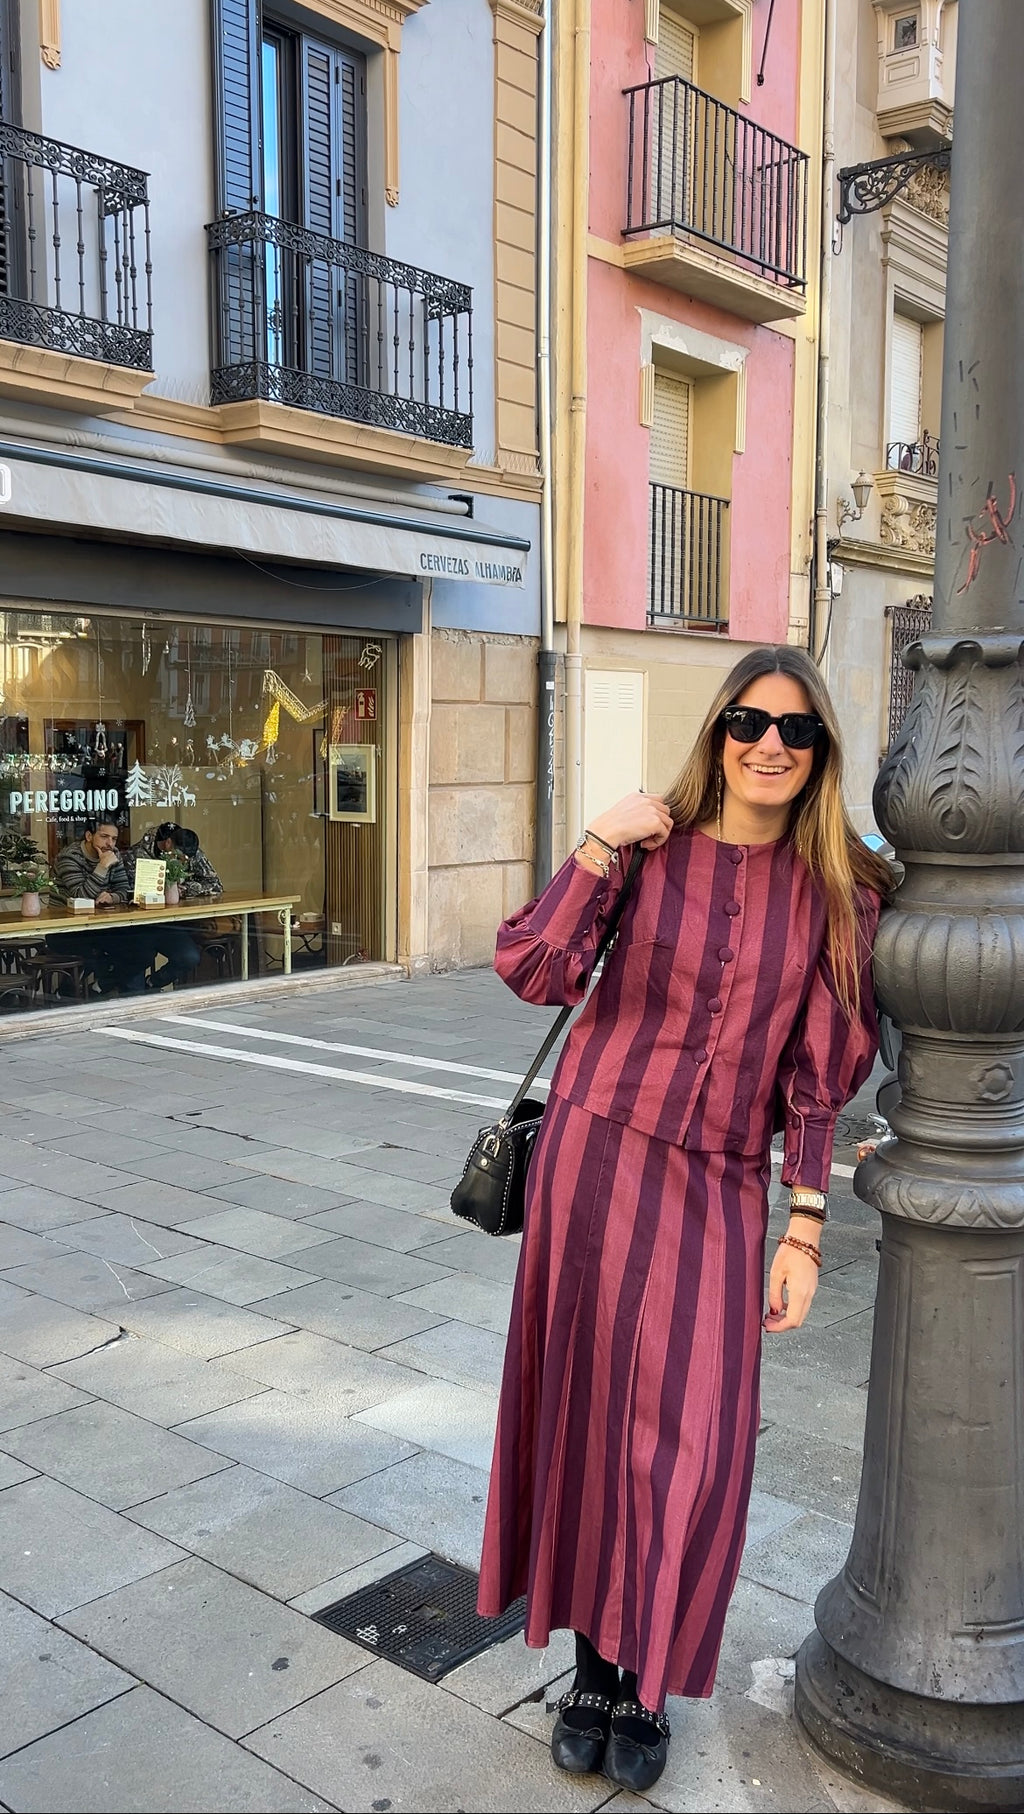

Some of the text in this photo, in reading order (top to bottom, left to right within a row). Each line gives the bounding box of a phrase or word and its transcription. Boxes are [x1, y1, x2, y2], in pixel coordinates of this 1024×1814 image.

[420, 553, 469, 575] CERVEZAS
[9, 789, 118, 814] PEREGRINO
[75, 815, 87, 823] shop
